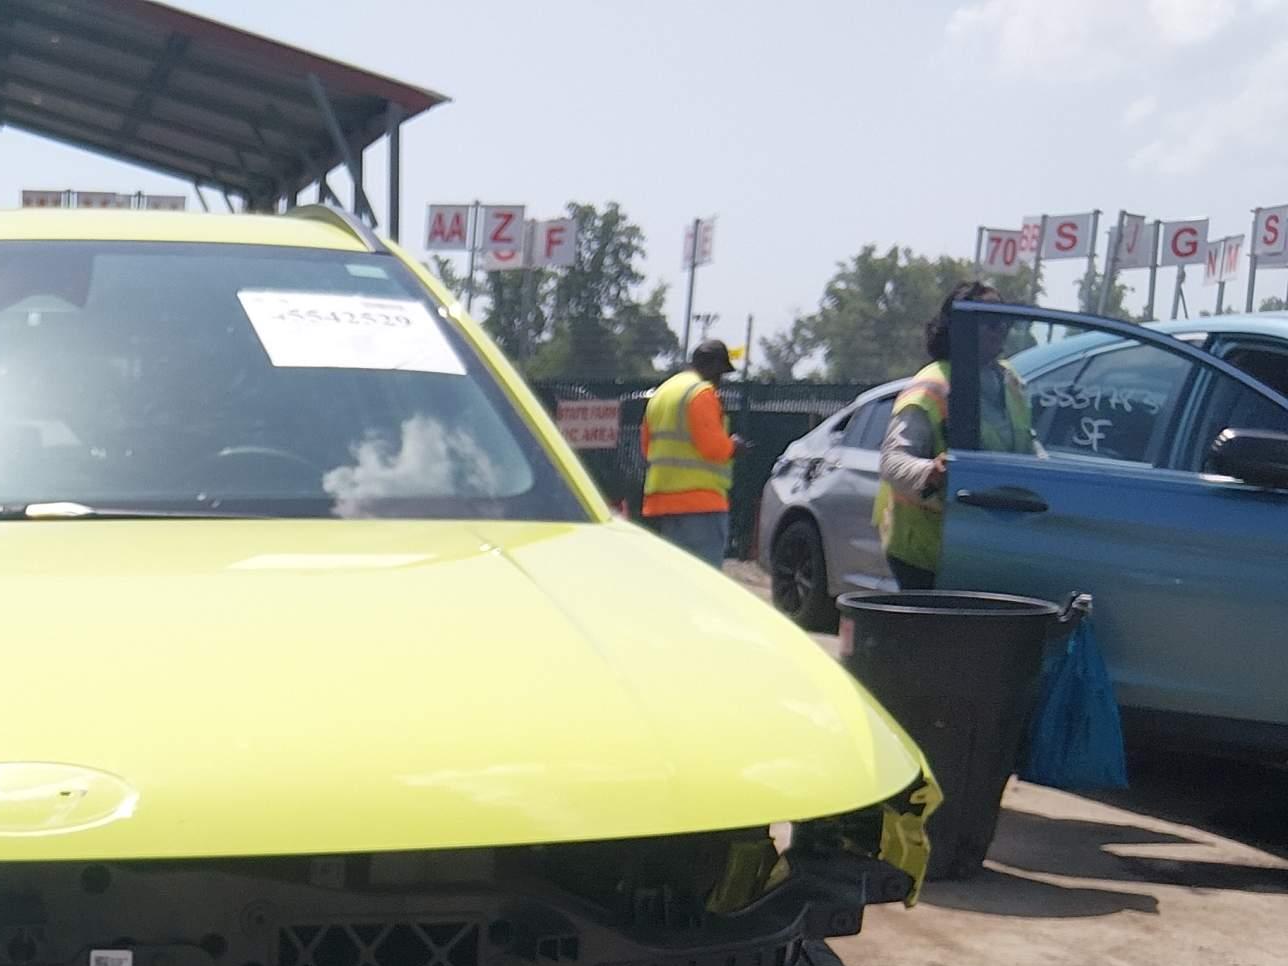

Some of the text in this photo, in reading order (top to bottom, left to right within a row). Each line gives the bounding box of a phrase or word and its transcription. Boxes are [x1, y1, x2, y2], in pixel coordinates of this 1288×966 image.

[428, 211, 466, 241] AA
[490, 211, 516, 243] Z
[544, 225, 567, 257] F
[1054, 222, 1079, 251] S
[1170, 226, 1199, 258] G
[1262, 213, 1280, 246] S
[987, 235, 1017, 266] 70
